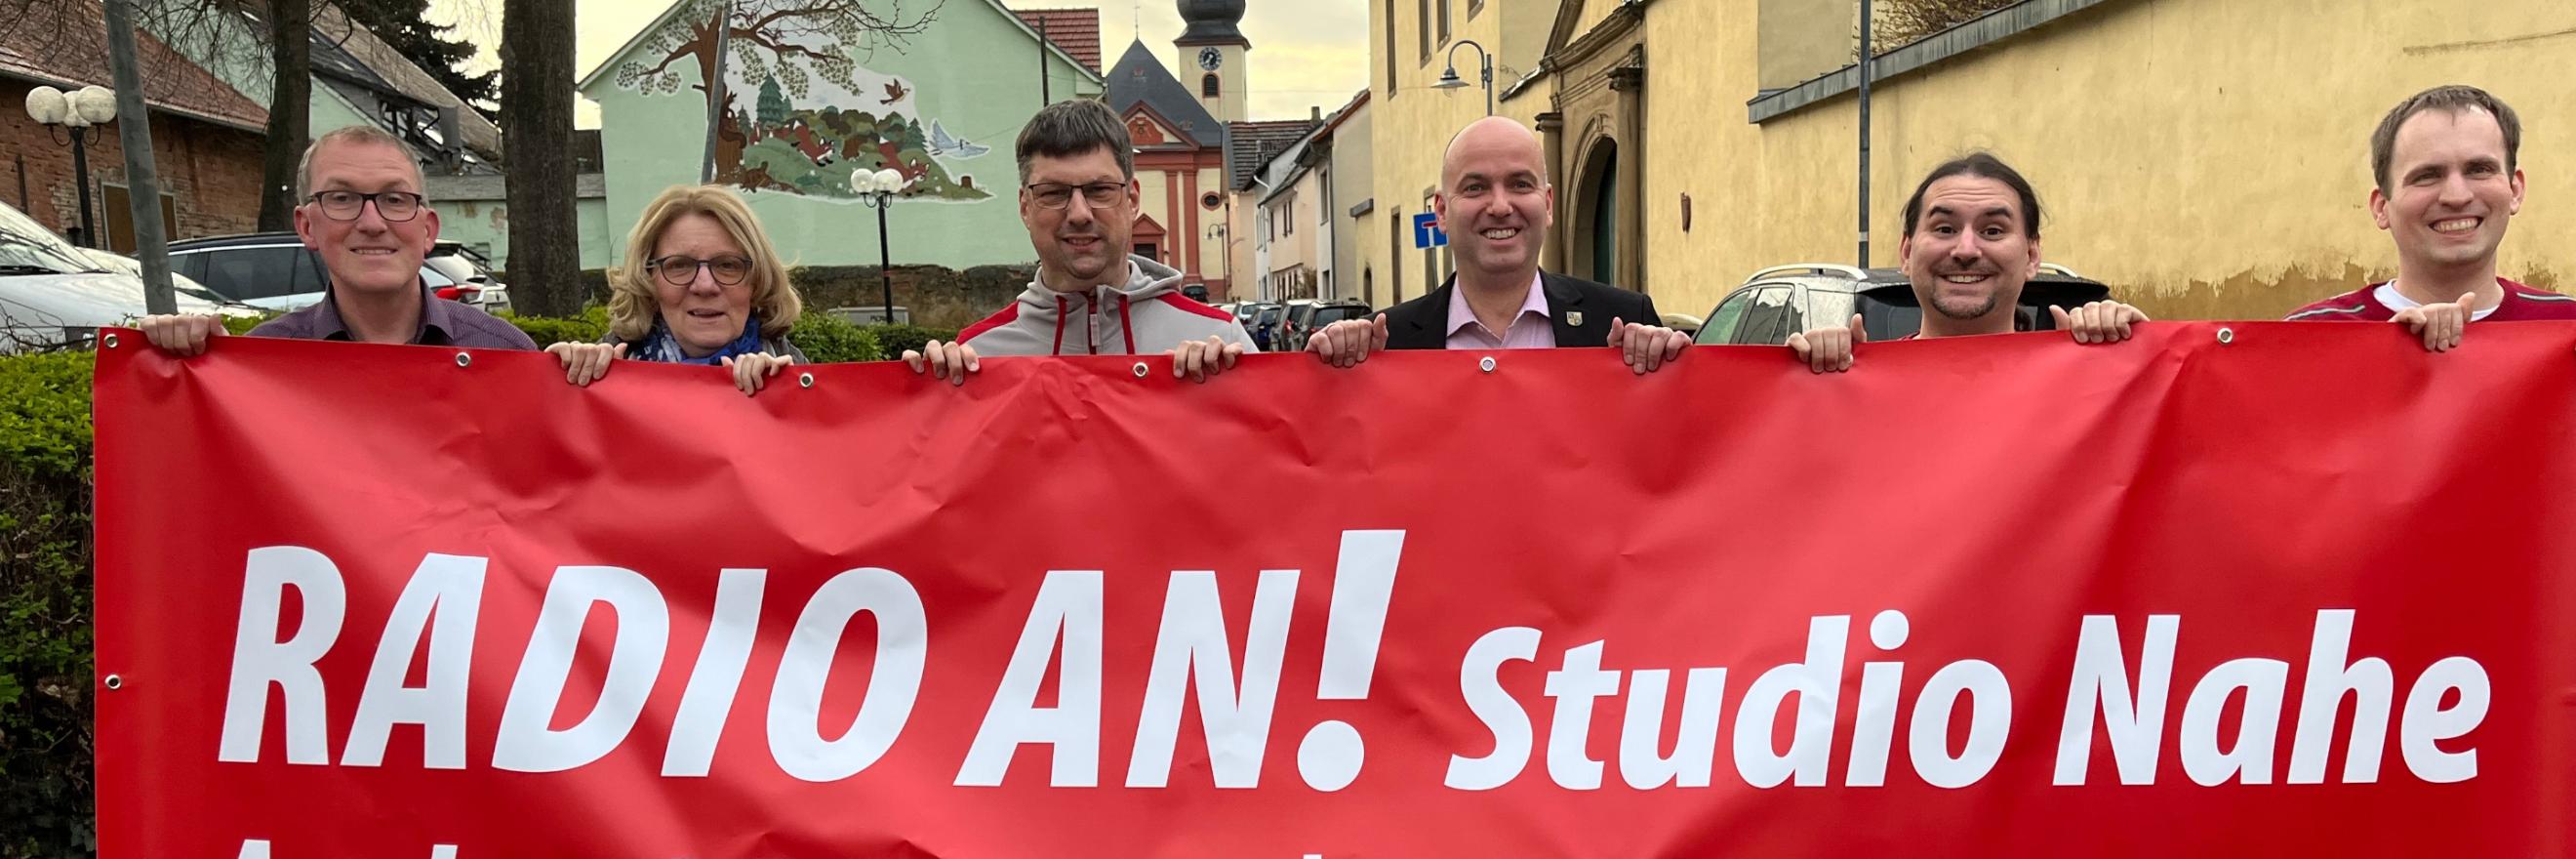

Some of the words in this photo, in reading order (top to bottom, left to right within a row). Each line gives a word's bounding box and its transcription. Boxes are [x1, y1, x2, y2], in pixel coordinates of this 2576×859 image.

[218, 545, 929, 783] RADIO
[952, 529, 1407, 793] AN!
[1444, 610, 2013, 791] Studio
[2052, 608, 2491, 787] Nahe
